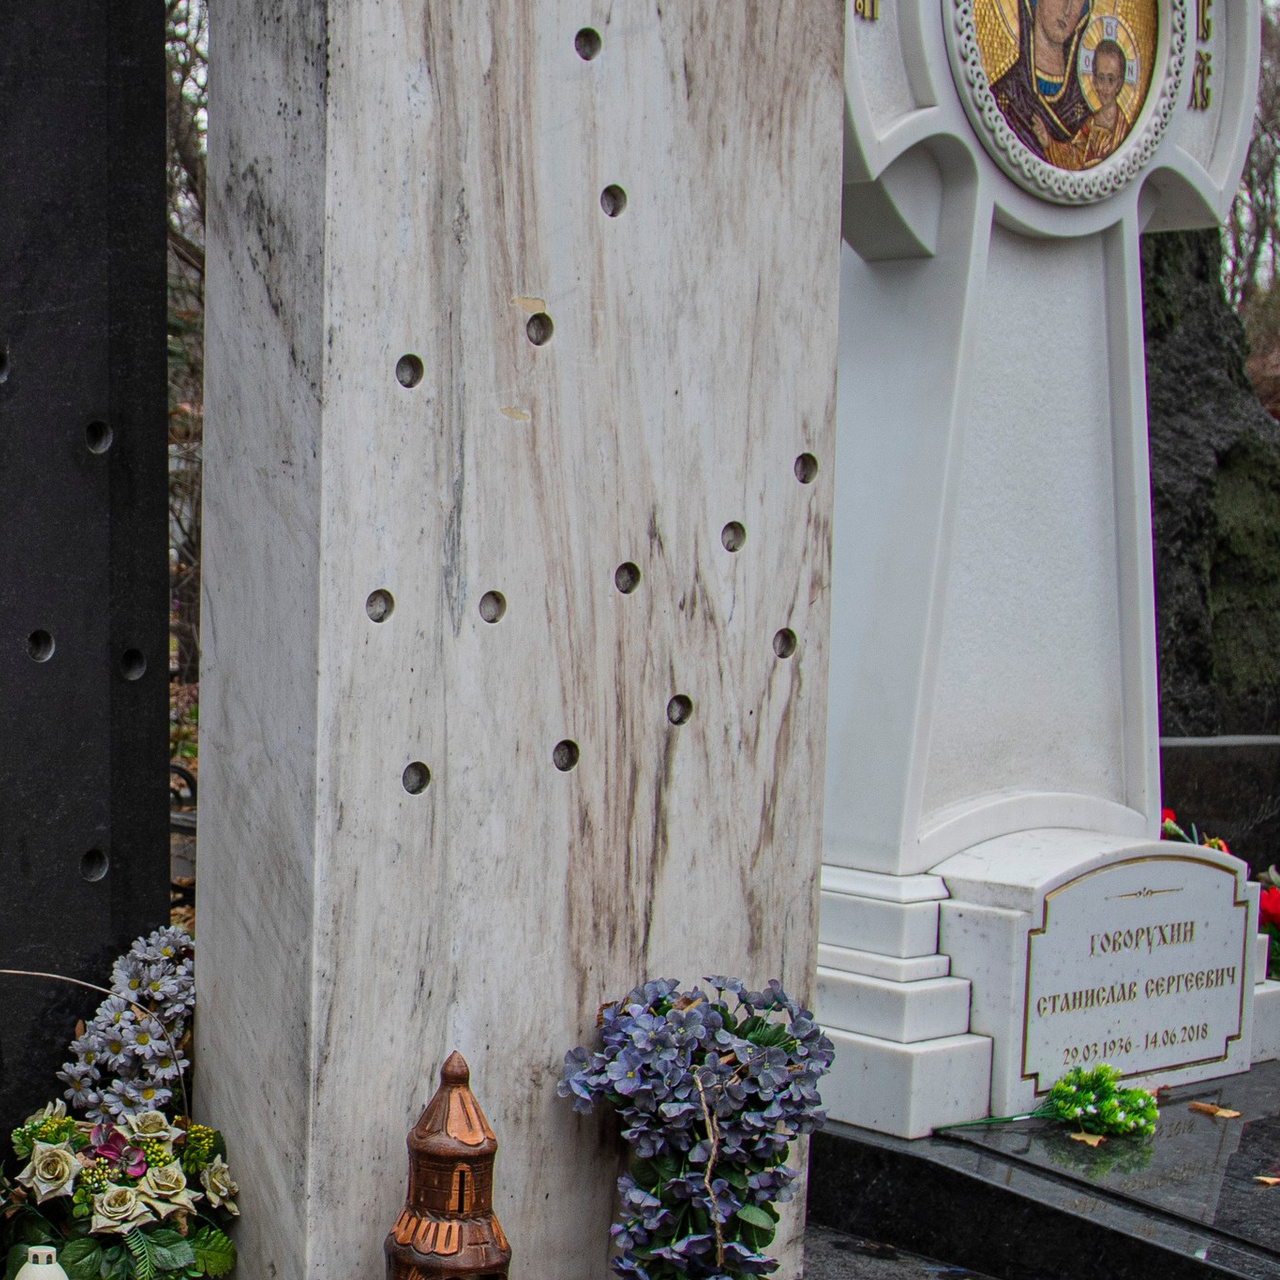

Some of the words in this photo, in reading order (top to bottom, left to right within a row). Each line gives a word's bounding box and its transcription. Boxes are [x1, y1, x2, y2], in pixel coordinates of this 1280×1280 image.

[1089, 920, 1195, 958] ГОВОРУХИН
[1037, 980, 1138, 1018] СТАНИСЛАВ
[1144, 966, 1237, 1000] СЕРГЕЕВИЧ
[1063, 1035, 1133, 1066] 29.03.1936
[1143, 1022, 1209, 1052] 14.06.2018
